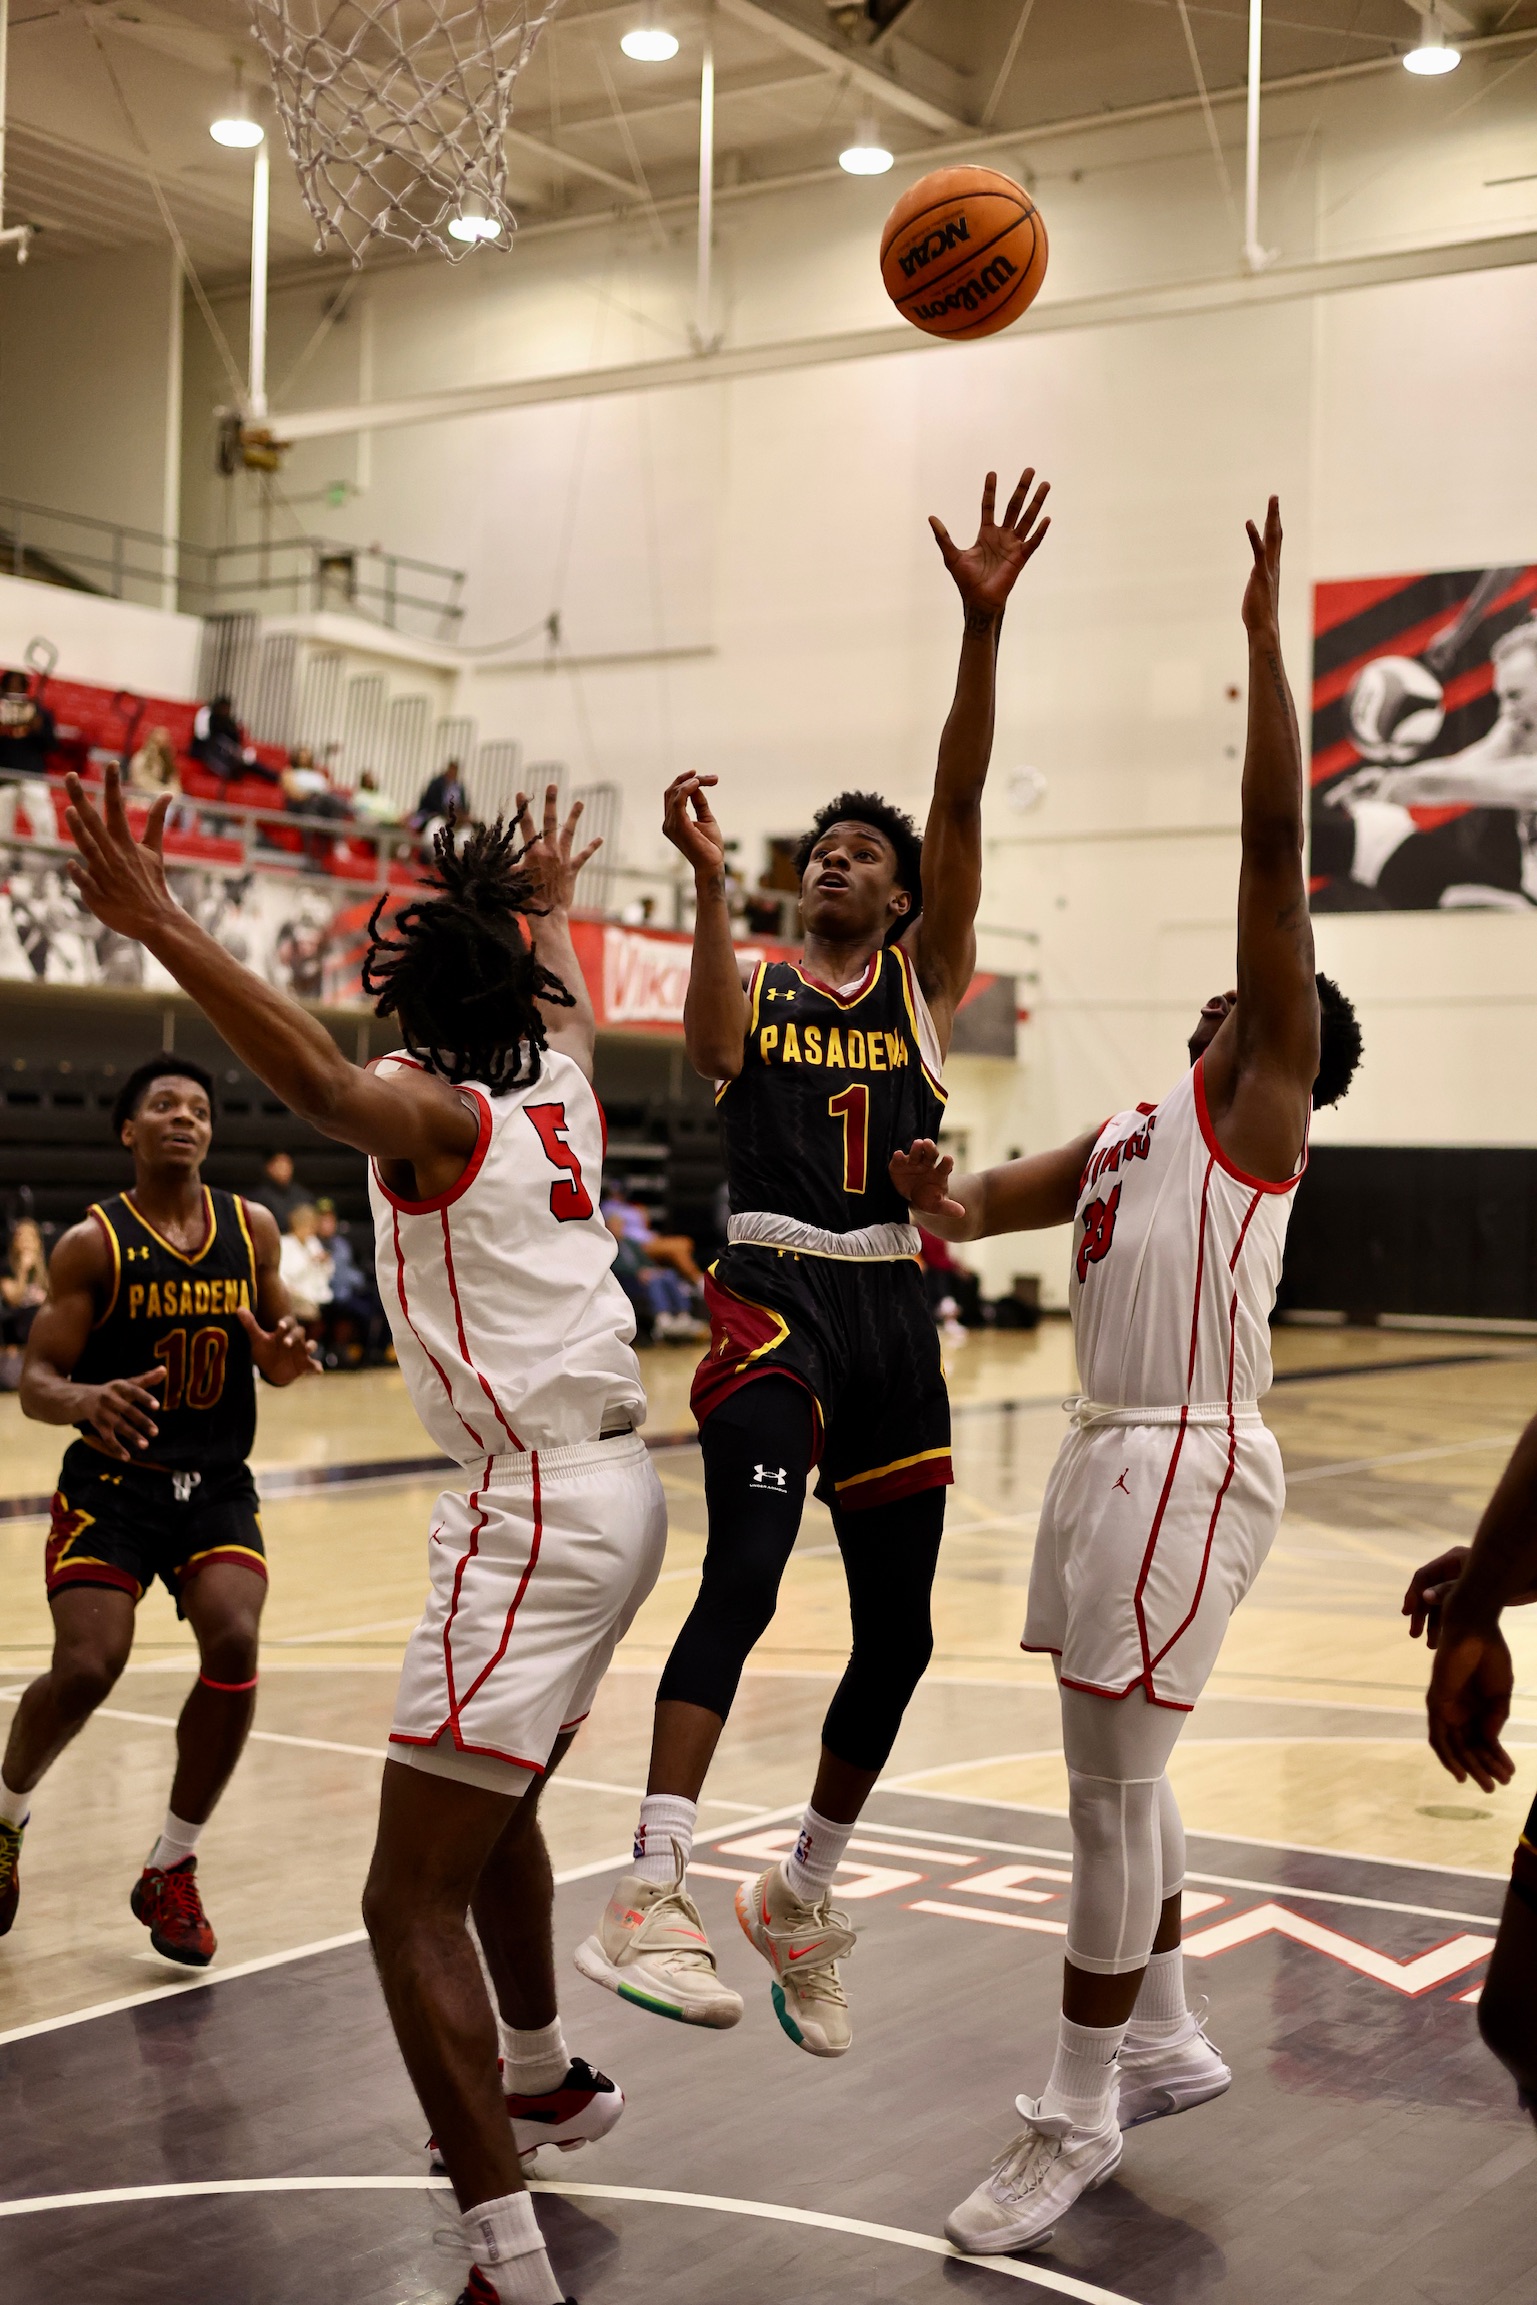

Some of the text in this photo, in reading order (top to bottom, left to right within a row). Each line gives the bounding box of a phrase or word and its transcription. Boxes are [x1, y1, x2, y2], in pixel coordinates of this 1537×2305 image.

[898, 217, 970, 278] NCAA
[911, 255, 1018, 320] Wilson
[760, 1023, 908, 1071] PASADENA
[522, 1102, 594, 1223] 5
[828, 1083, 869, 1195] 1
[129, 1279, 250, 1320] PASADENA
[154, 1326, 229, 1411] 10
